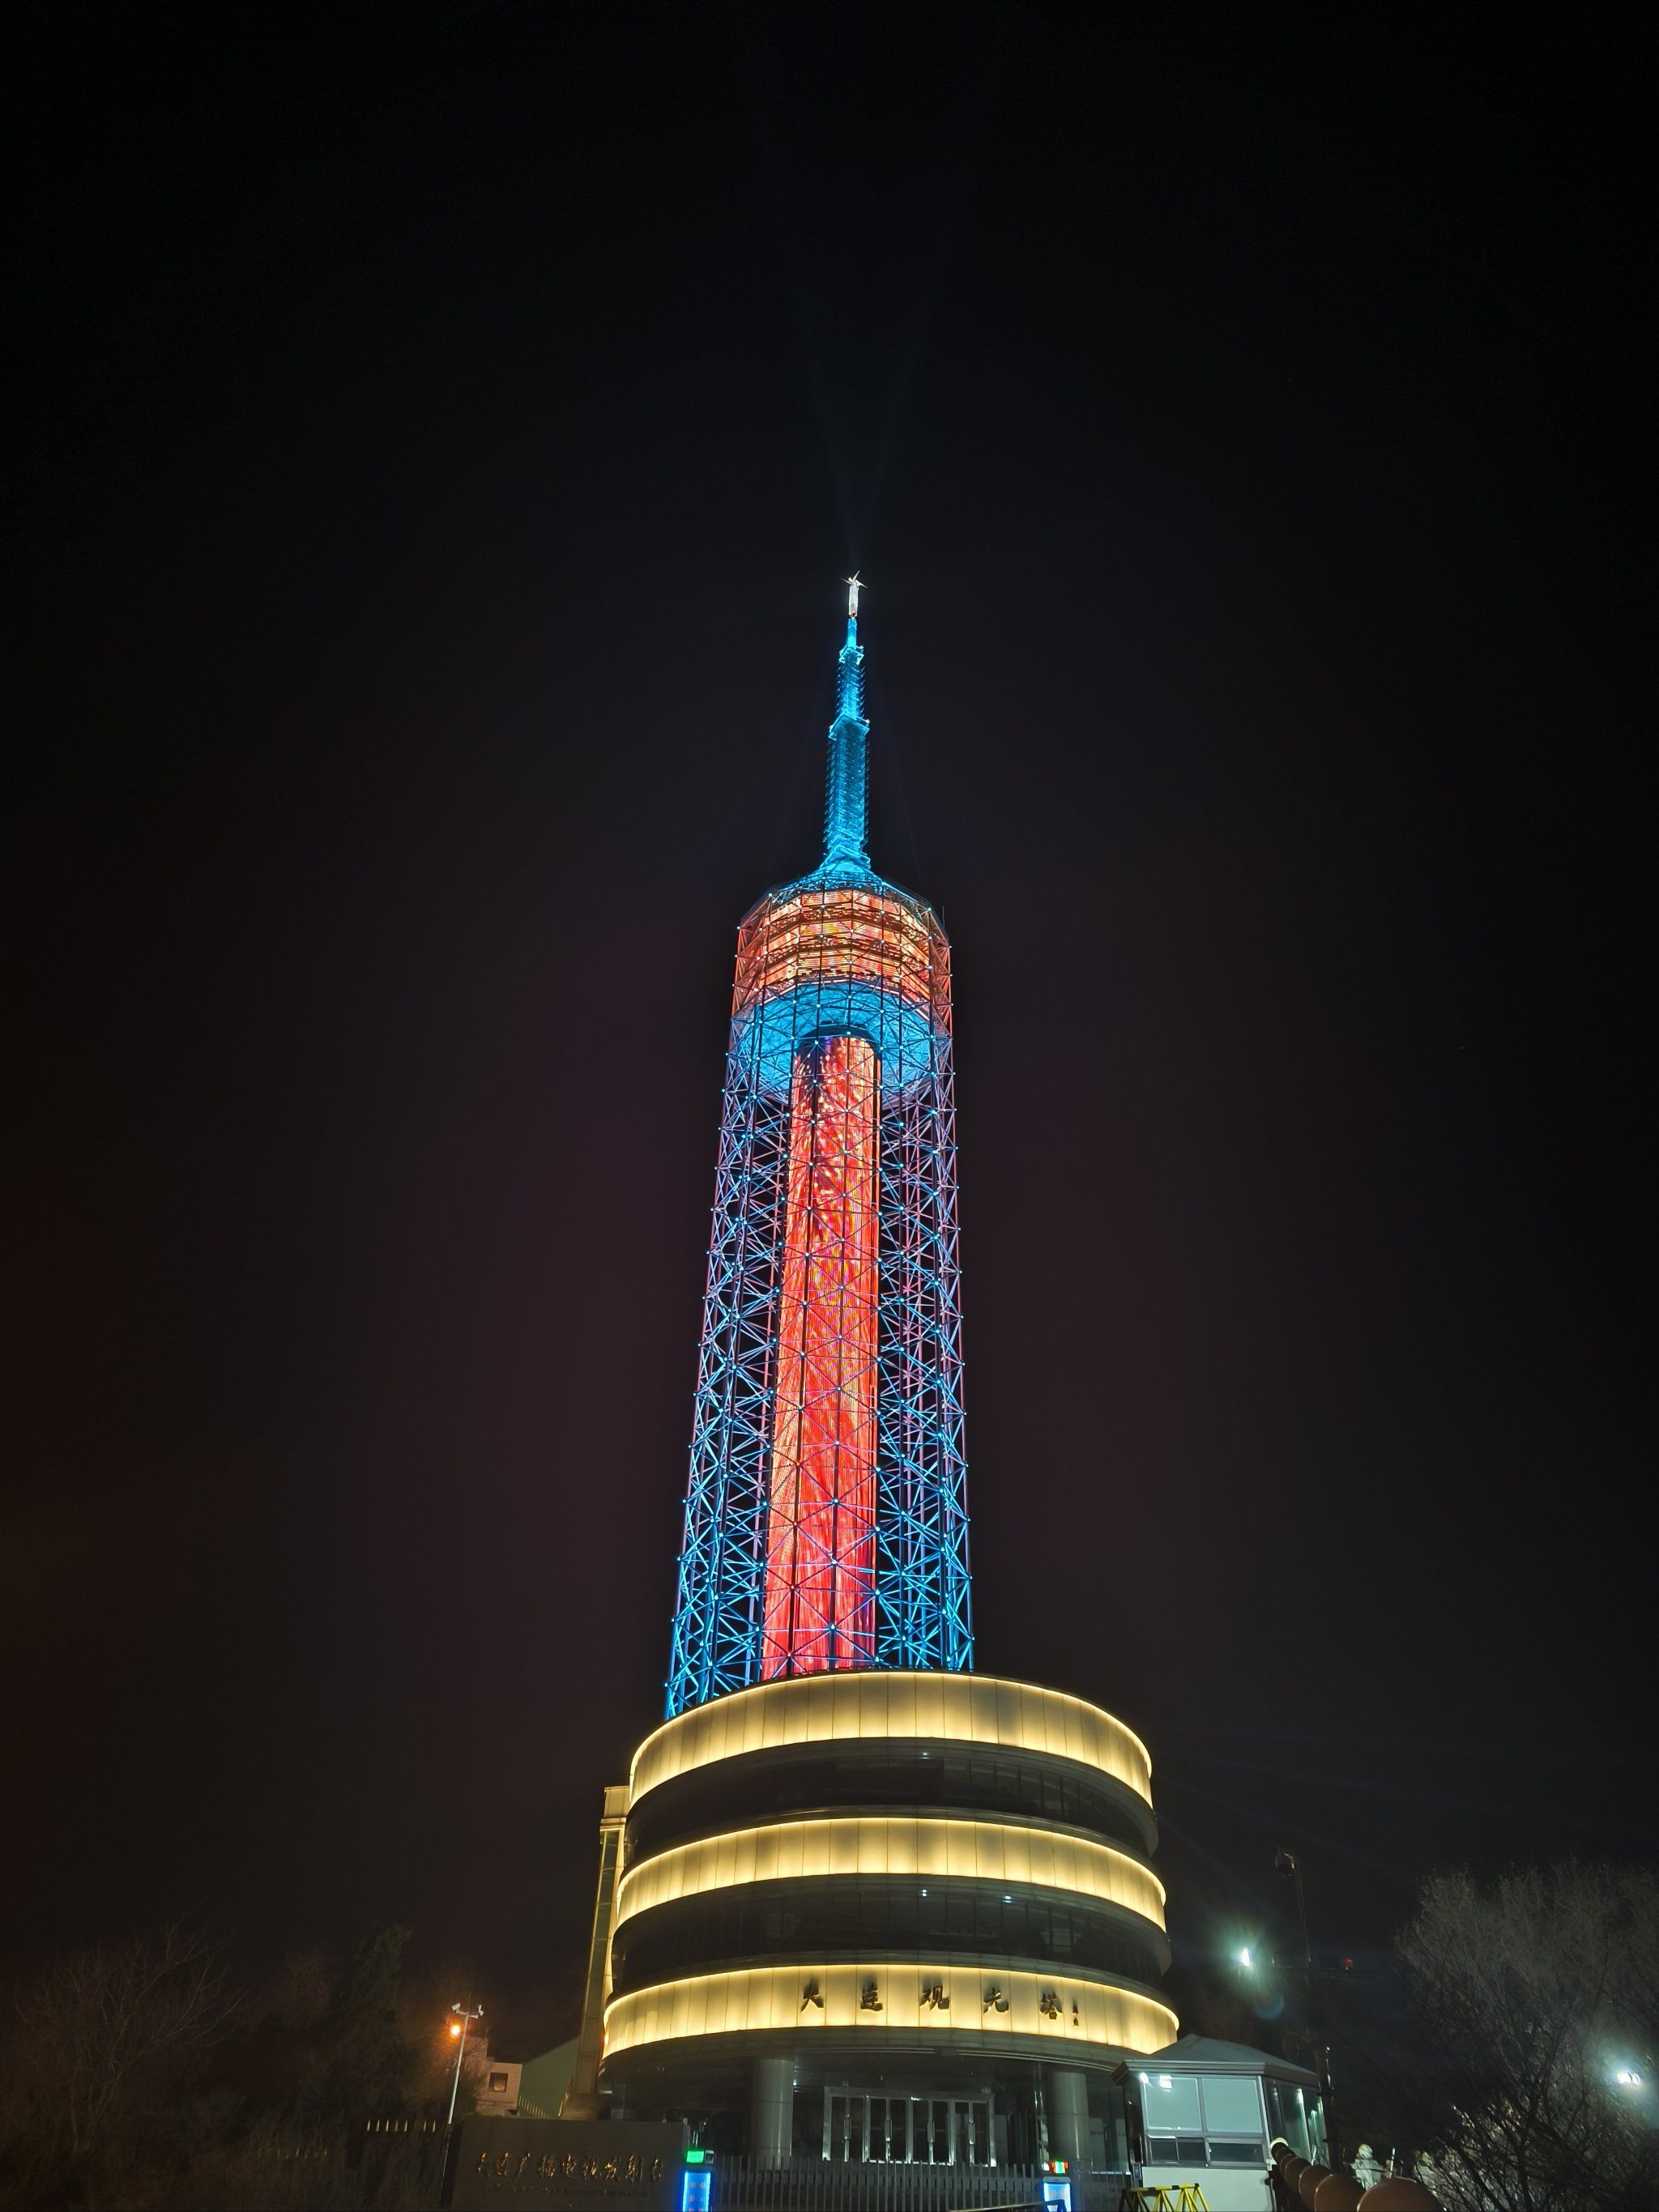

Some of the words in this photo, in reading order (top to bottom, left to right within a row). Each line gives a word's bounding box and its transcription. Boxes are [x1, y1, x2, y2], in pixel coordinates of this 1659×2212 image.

[800, 1979, 1064, 2020] 大连观光塔
